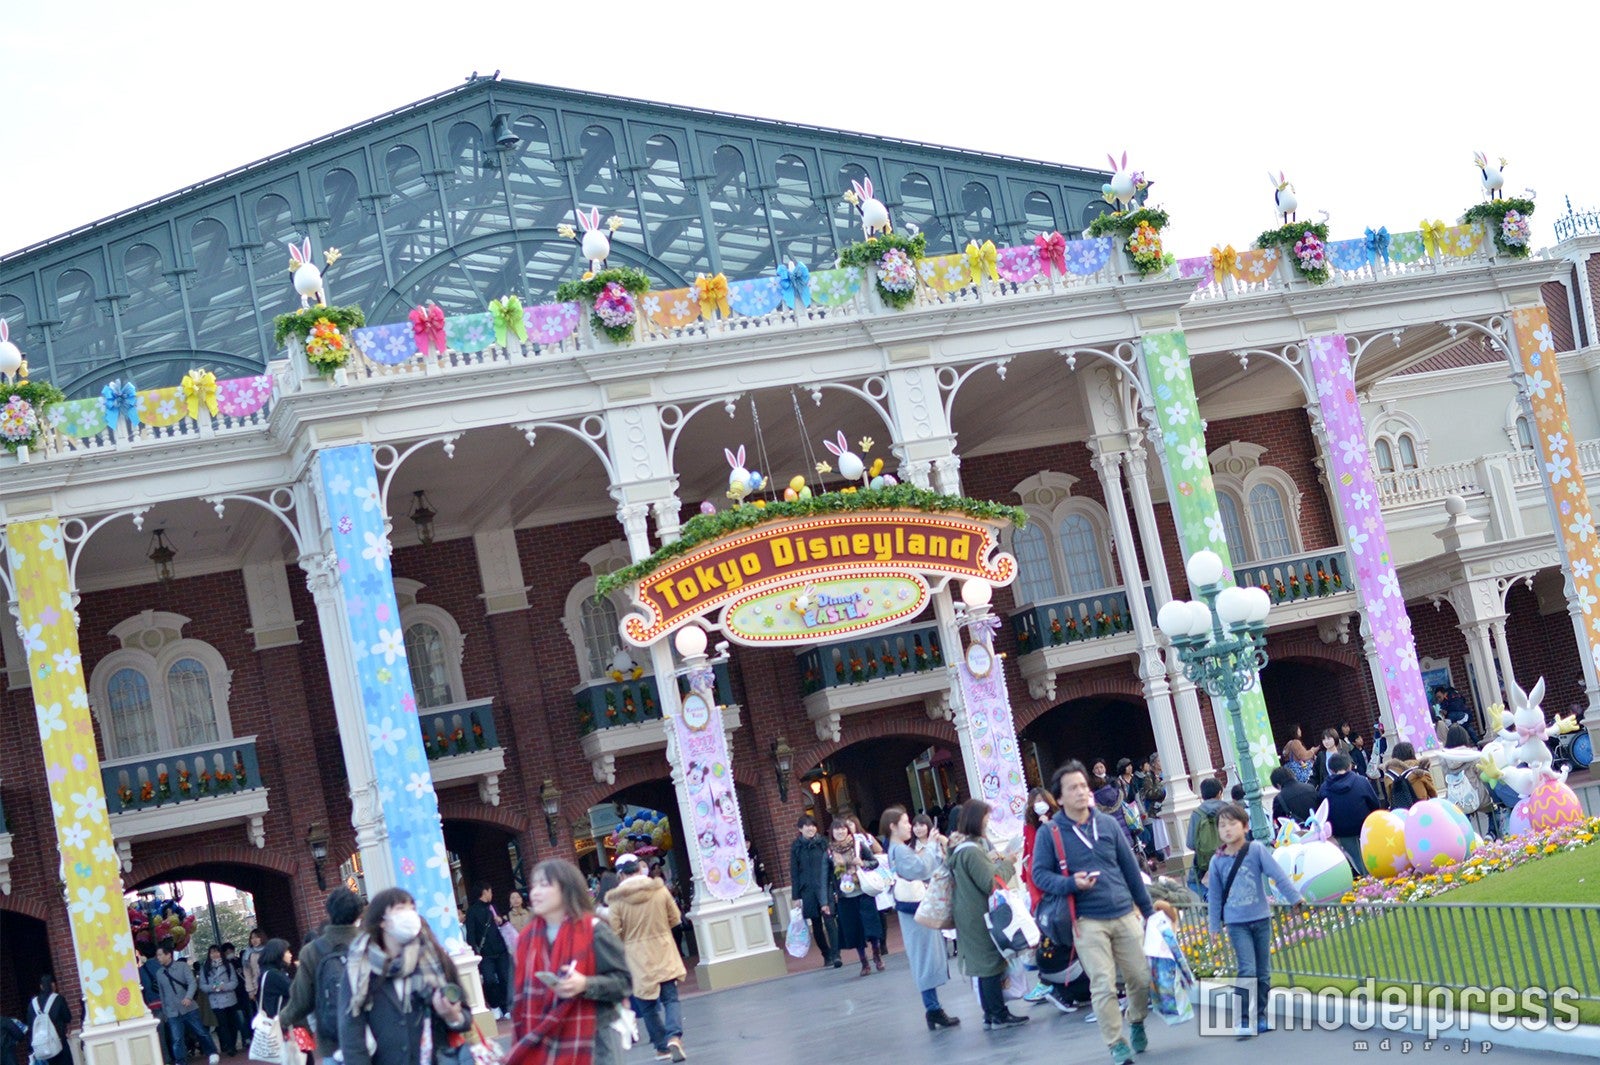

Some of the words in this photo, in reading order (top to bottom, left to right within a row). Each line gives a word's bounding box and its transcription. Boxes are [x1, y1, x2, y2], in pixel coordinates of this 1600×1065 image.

[654, 551, 762, 609] Tokyo
[768, 527, 970, 568] Disneyland
[802, 602, 869, 628] EASTER
